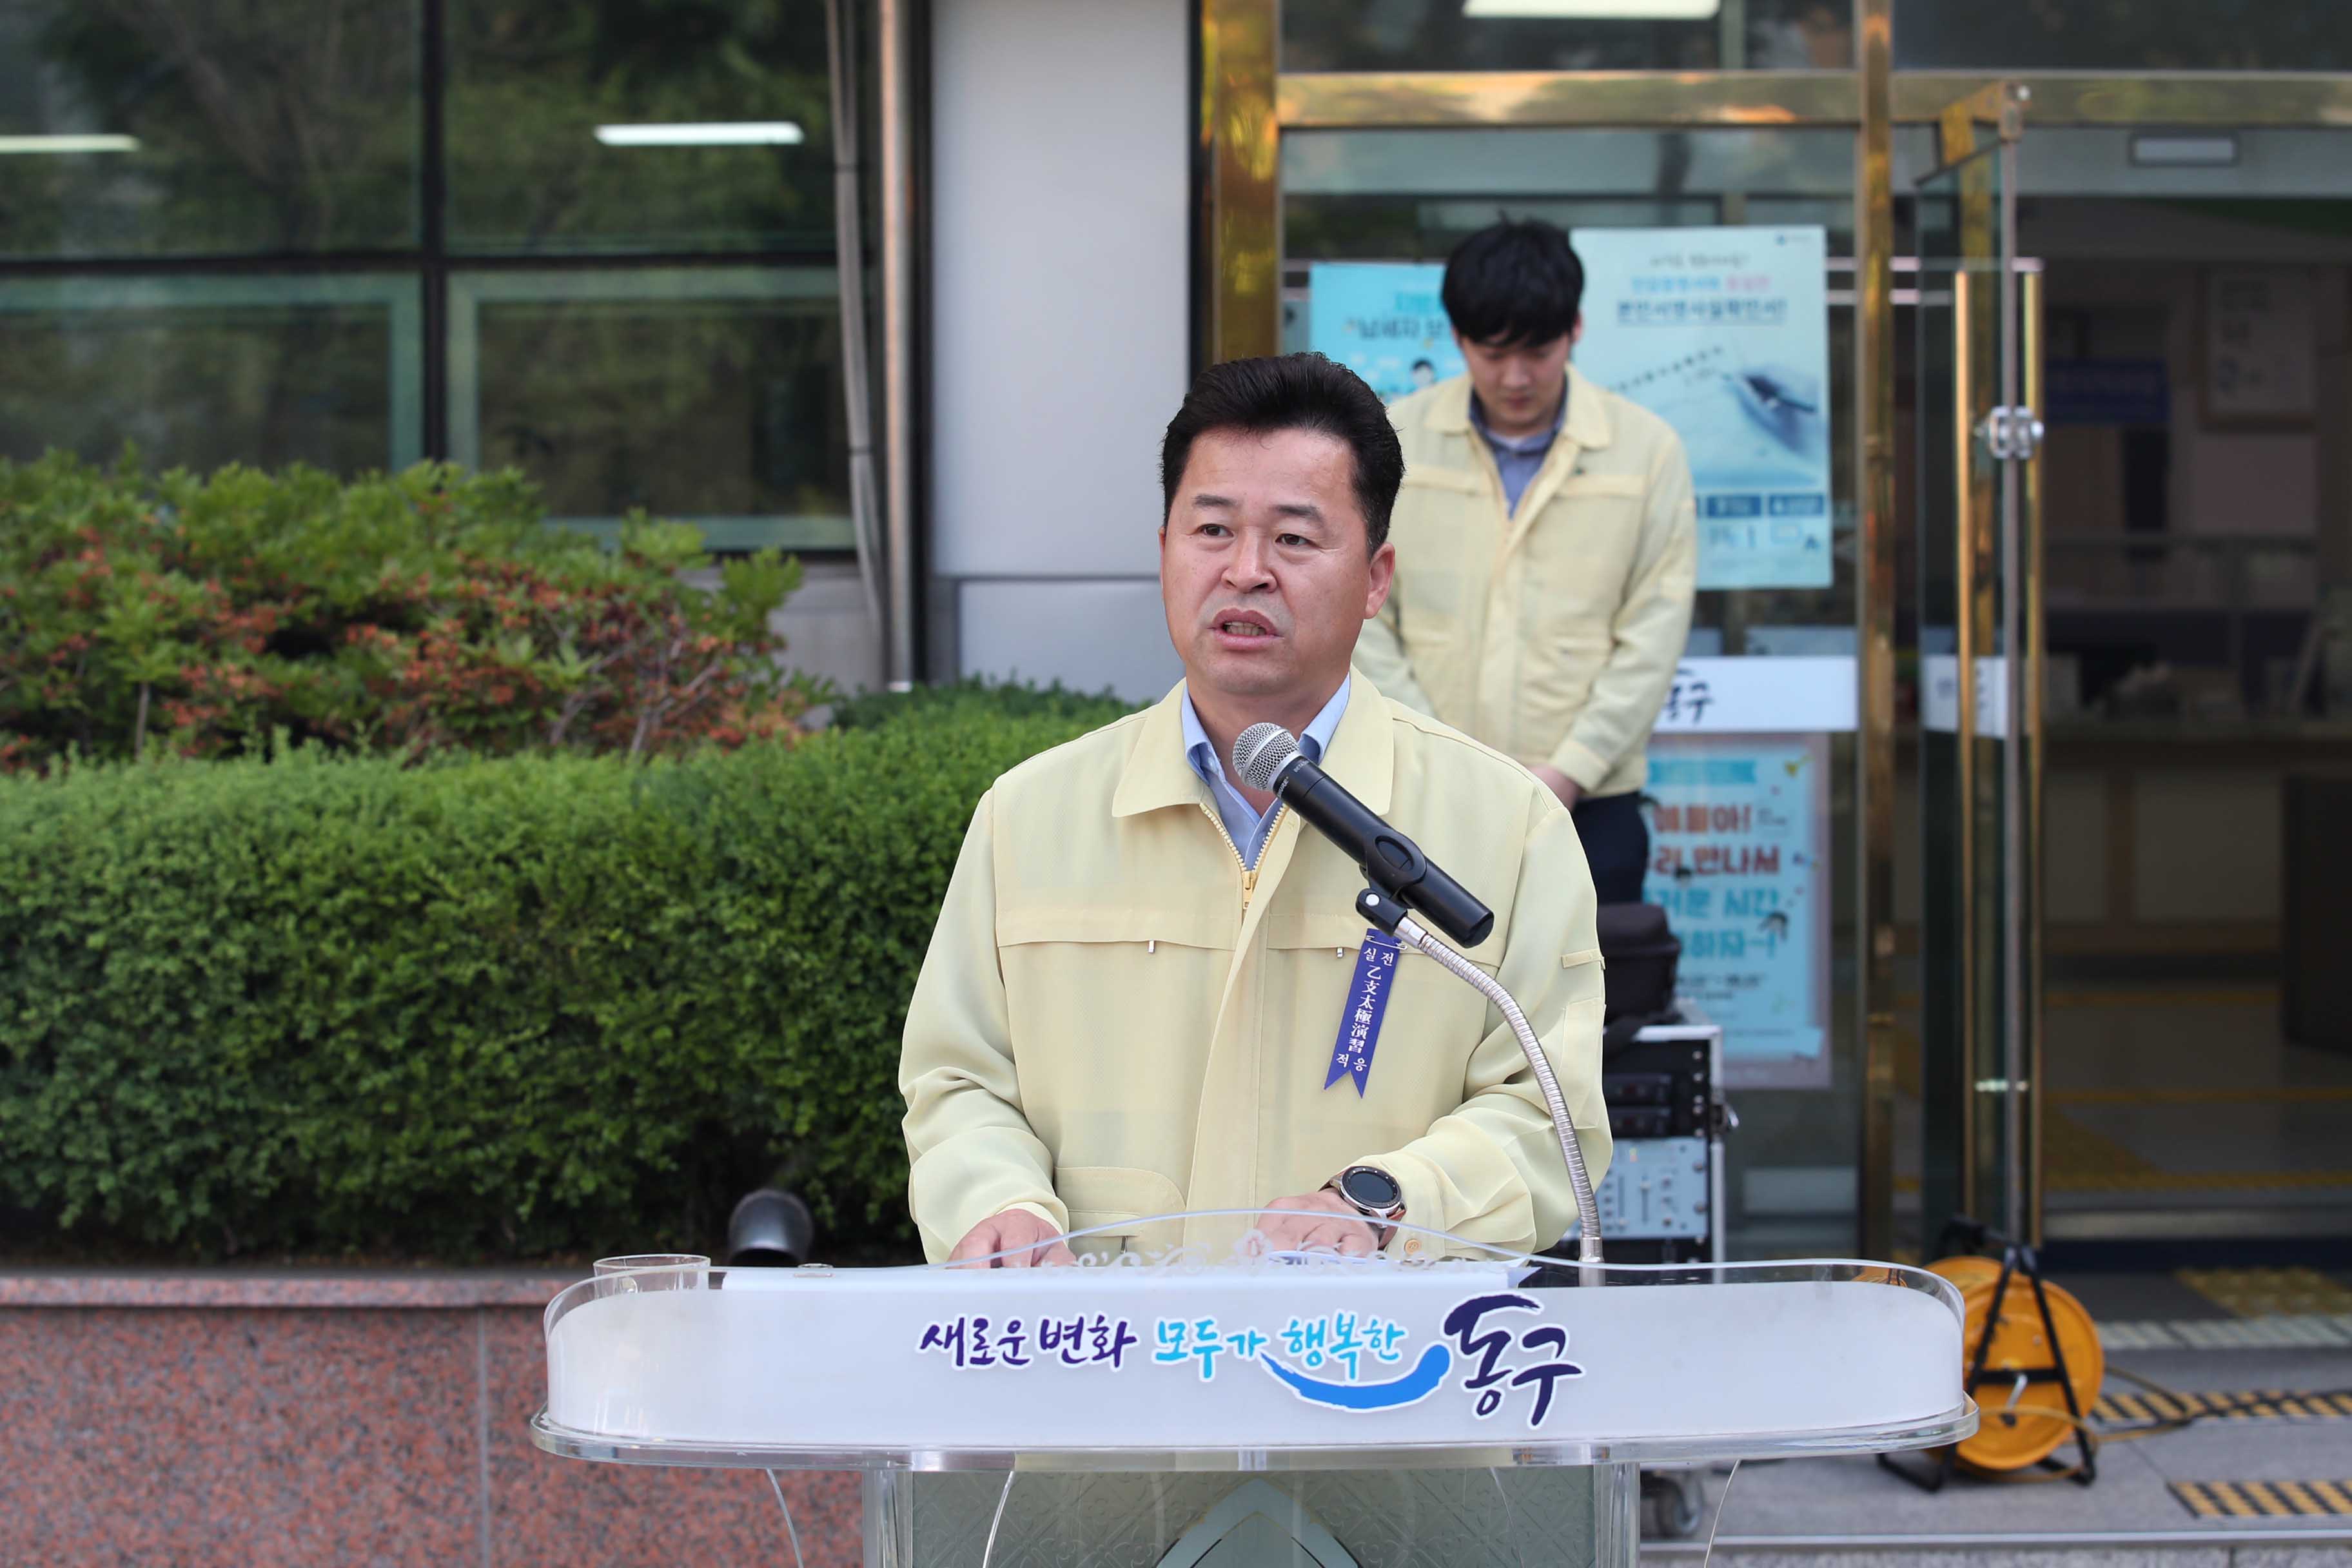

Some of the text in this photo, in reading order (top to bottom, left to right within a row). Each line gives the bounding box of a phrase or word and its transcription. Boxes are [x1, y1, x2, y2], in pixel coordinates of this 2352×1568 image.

[919, 1293, 1583, 1427] 새로운 변화 모두가 행복한 동구
